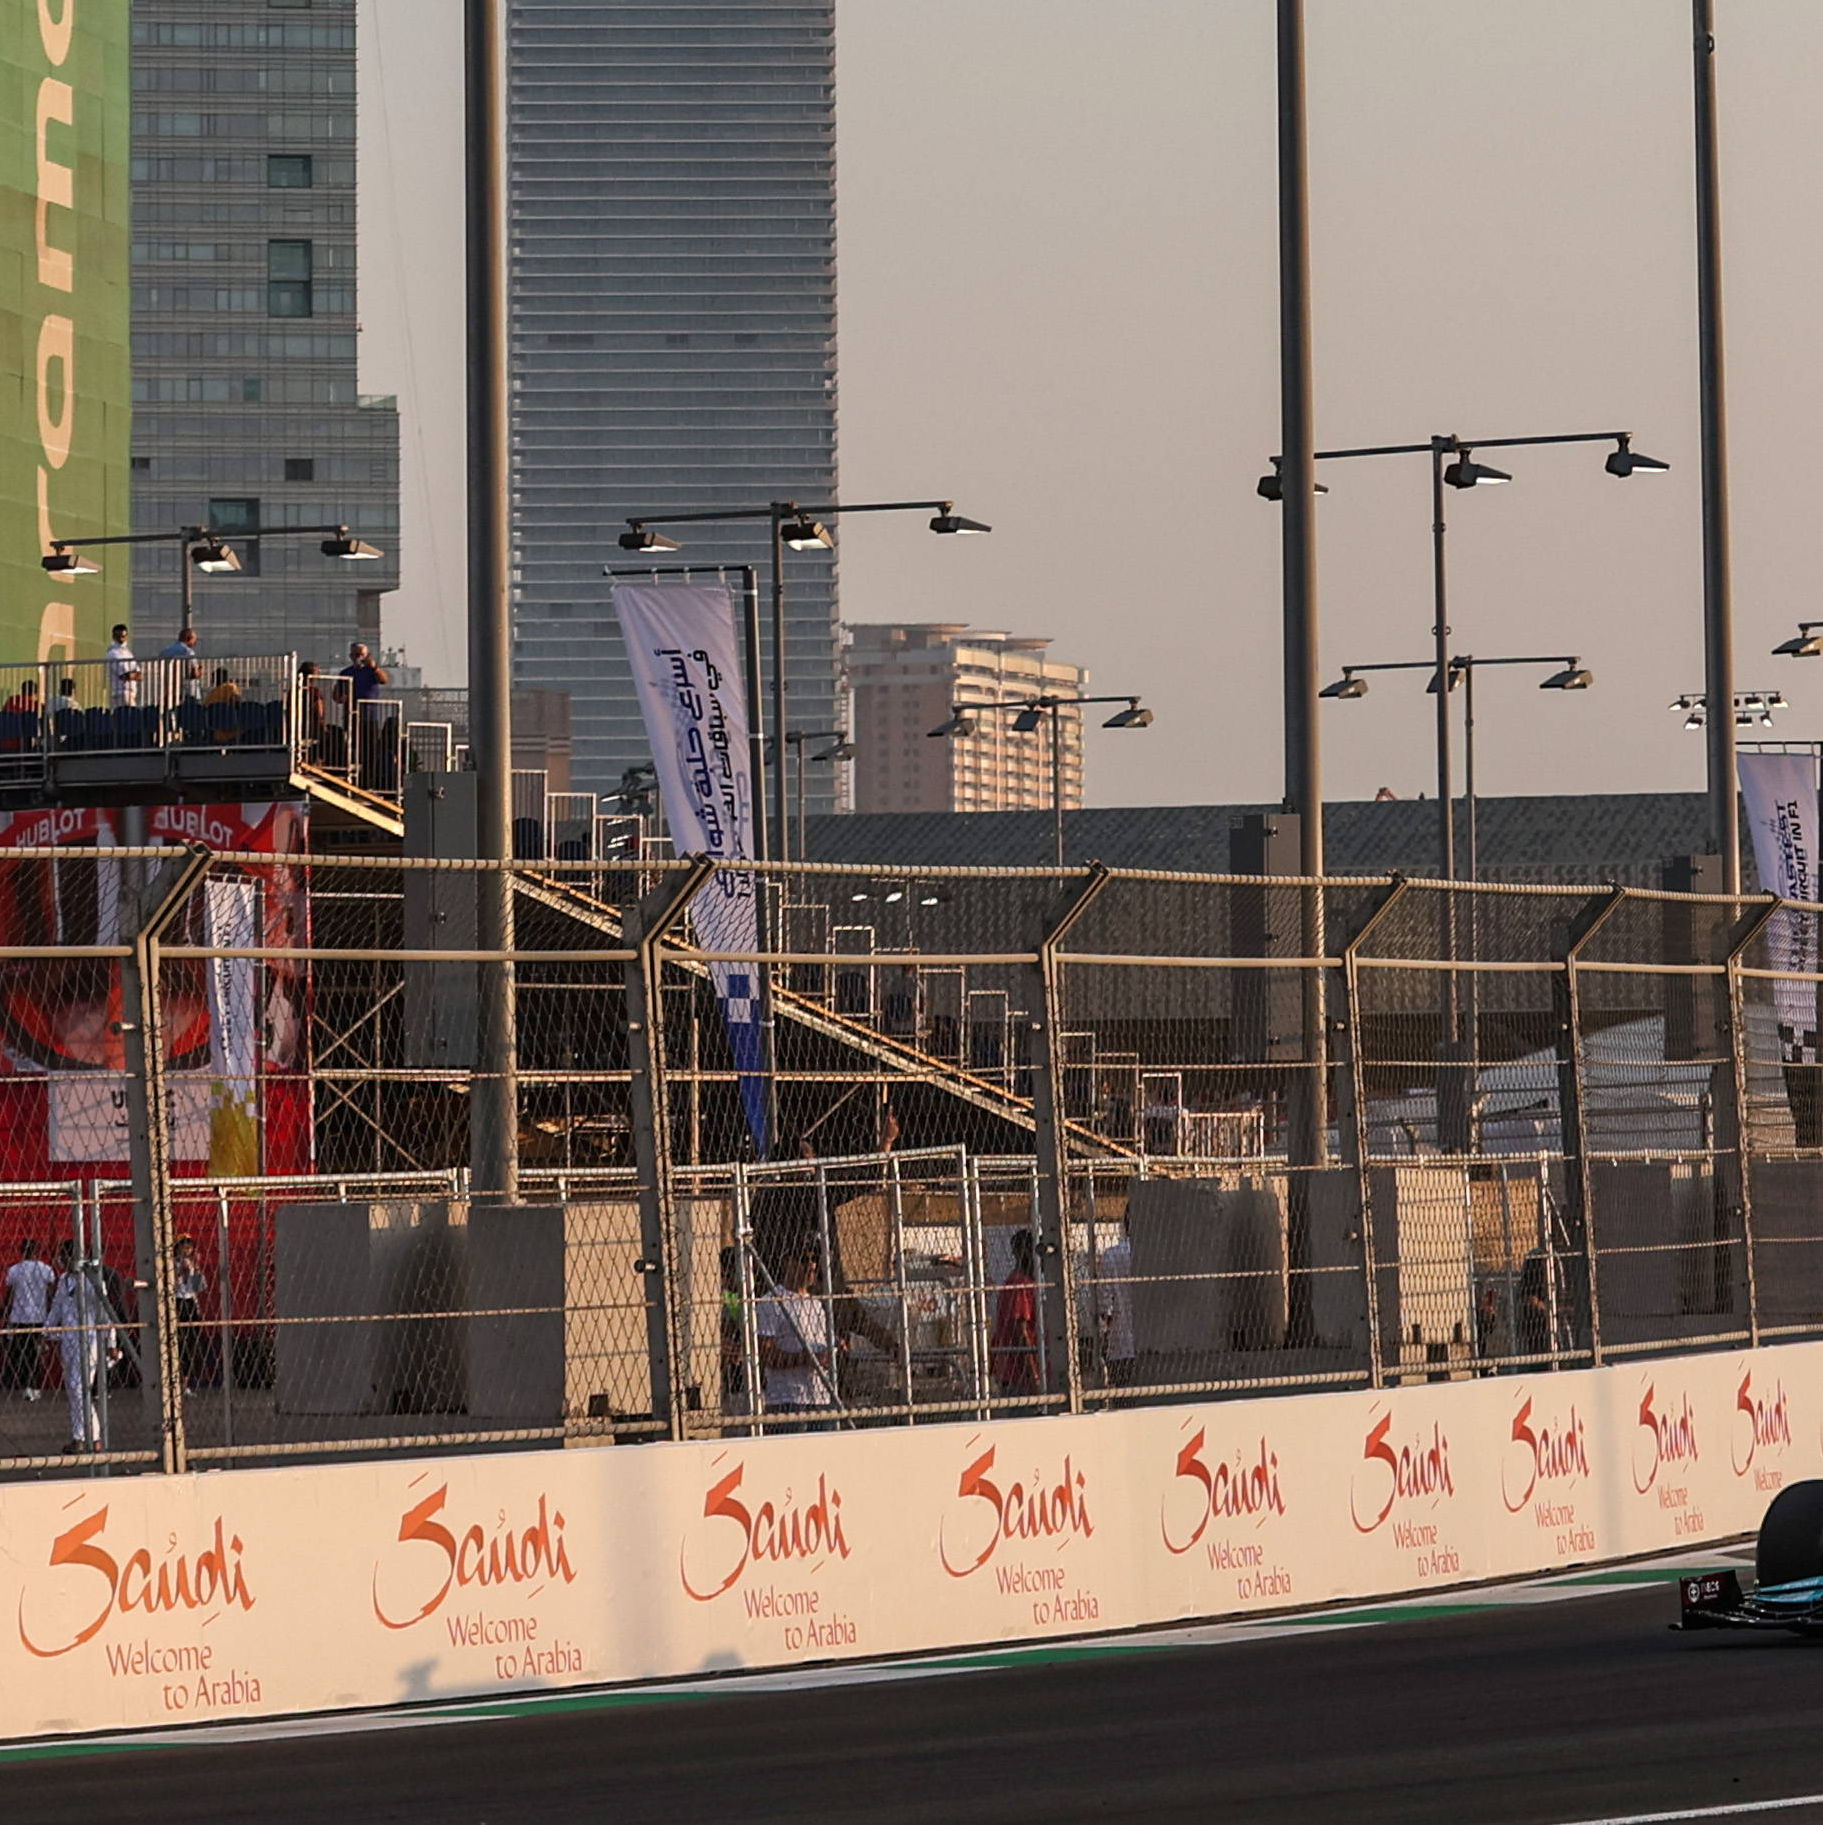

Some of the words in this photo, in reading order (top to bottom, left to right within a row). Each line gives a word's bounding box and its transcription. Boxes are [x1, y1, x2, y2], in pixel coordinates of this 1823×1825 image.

[15, 809, 85, 849] HUBLOT
[154, 805, 234, 849] HUBLOT
[1787, 801, 1799, 819] F1
[1790, 823, 1803, 841] IN
[1775, 799, 1799, 905] ASTEST
[1794, 844, 1809, 905] IRCUIT
[1631, 1381, 1700, 1495] Saudi
[1730, 1368, 1793, 1477] Saudi
[1350, 1409, 1455, 1534] Saudi
[1502, 1395, 1591, 1514] Saudi
[1161, 1425, 1287, 1555] Saudi
[939, 1443, 1096, 1578] Saudi
[1534, 1499, 1575, 1530] Welcome
[680, 1460, 852, 1602] Saudi
[1392, 1520, 1438, 1550] Welcome
[1556, 1531, 1568, 1556] to
[1568, 1523, 1596, 1554] Arabia
[372, 1481, 578, 1631] Saudi
[1206, 1538, 1264, 1571] Welcome
[1417, 1552, 1430, 1579] to
[1430, 1543, 1461, 1576] Arabia
[18, 1503, 258, 1658] Saudi
[995, 1562, 1066, 1596] Welcome
[1237, 1574, 1253, 1602] to
[1254, 1565, 1292, 1597] Arabia
[743, 1585, 820, 1620] Welcome
[1033, 1598, 1051, 1626] to
[1052, 1591, 1100, 1624] Arabia
[445, 1611, 538, 1648] Welcome
[783, 1624, 804, 1652] to
[805, 1614, 857, 1650] Arabia
[105, 1640, 213, 1678] Welcome
[494, 1652, 518, 1681] to
[521, 1644, 583, 1679] Arabia
[162, 1681, 188, 1711] to
[193, 1673, 261, 1707] Arabia
